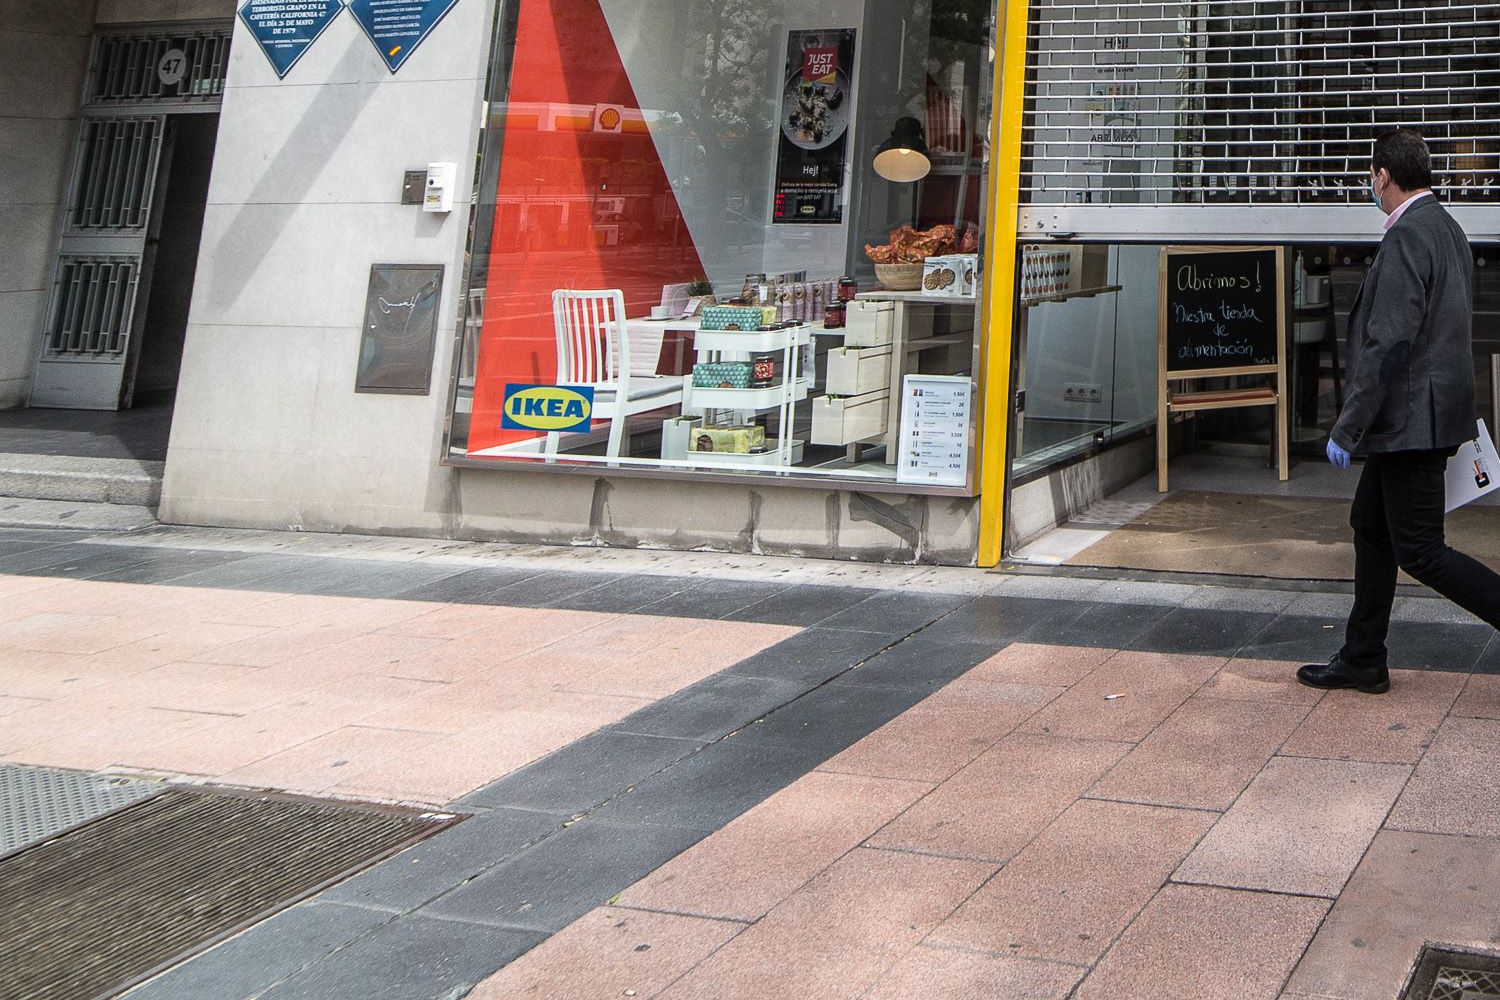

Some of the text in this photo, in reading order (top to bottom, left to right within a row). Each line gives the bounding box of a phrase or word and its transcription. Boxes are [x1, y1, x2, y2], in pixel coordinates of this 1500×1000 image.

[250, 12, 279, 20] CAFETERÍA
[162, 59, 181, 74] 47
[808, 54, 833, 66] JUST
[812, 64, 832, 74] EAT
[803, 165, 819, 177] Hej!
[1218, 299, 1263, 323] tienda
[1213, 323, 1230, 337] de
[512, 397, 584, 418] IKEA
